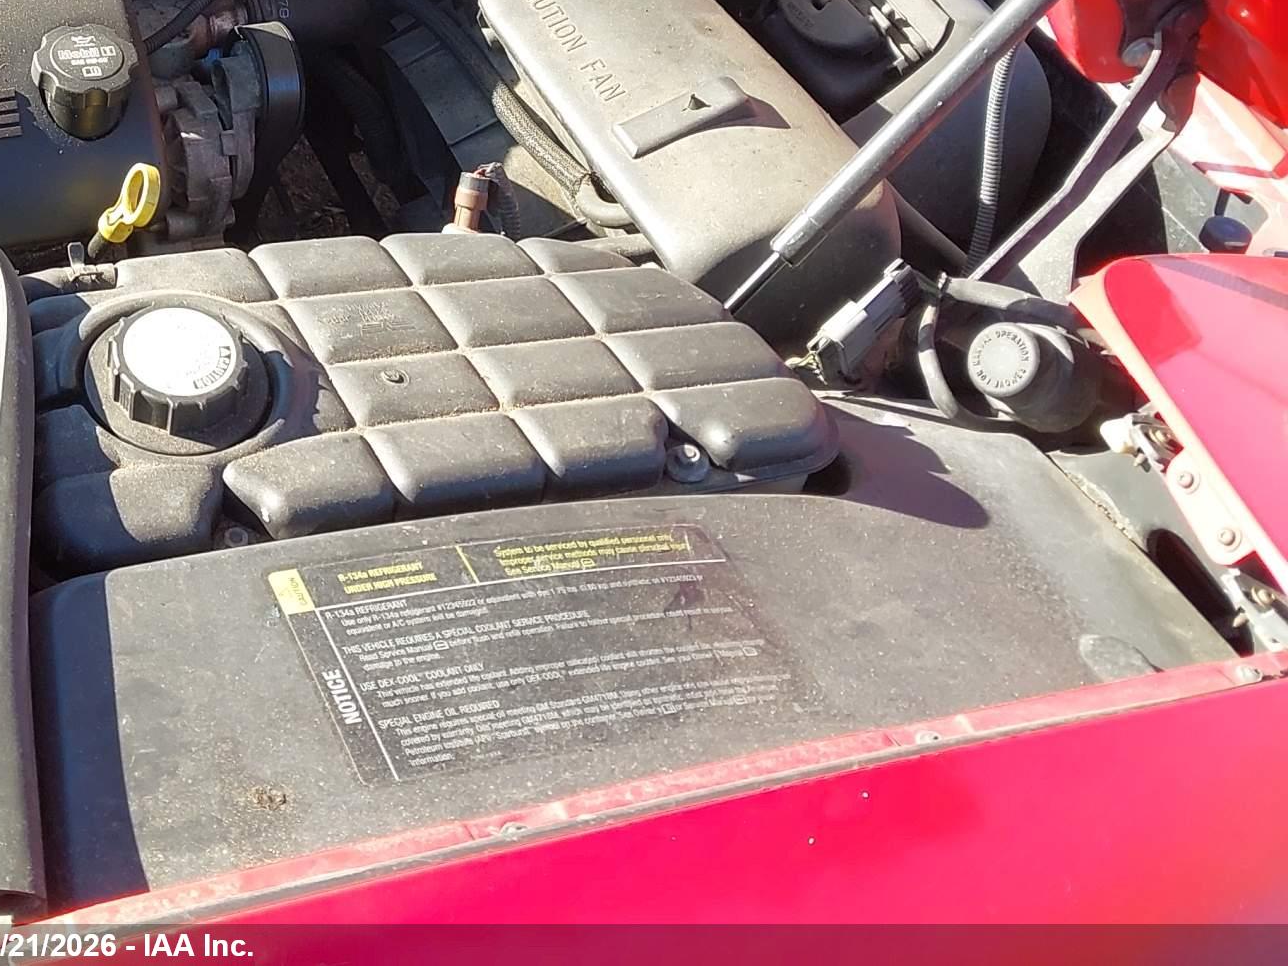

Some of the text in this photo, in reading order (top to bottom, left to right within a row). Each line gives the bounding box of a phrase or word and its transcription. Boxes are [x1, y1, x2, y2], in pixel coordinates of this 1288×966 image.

[57, 46, 100, 60] Mobil
[580, 58, 626, 102] FAN
[336, 562, 424, 582] R-134a REFRIGERANT
[343, 573, 437, 594] UNDER HIGH PRESSURE
[324, 600, 408, 619] R-134a REFRIGERANT
[341, 645, 361, 654] THIS
[361, 639, 395, 651] VEHICLE
[394, 633, 435, 646] REQUIRES
[441, 627, 474, 637] SPECIAL
[474, 621, 511, 632] COOLANT
[511, 616, 544, 627] SERVICE
[544, 610, 589, 623] PROCEDURE
[359, 682, 377, 691] USE
[424, 667, 463, 679] COOLANT
[462, 662, 485, 672] ONLY
[322, 669, 362, 725] NOTICE
[377, 701, 500, 729] SPECIAL ENGINE OIL REQUIRED
